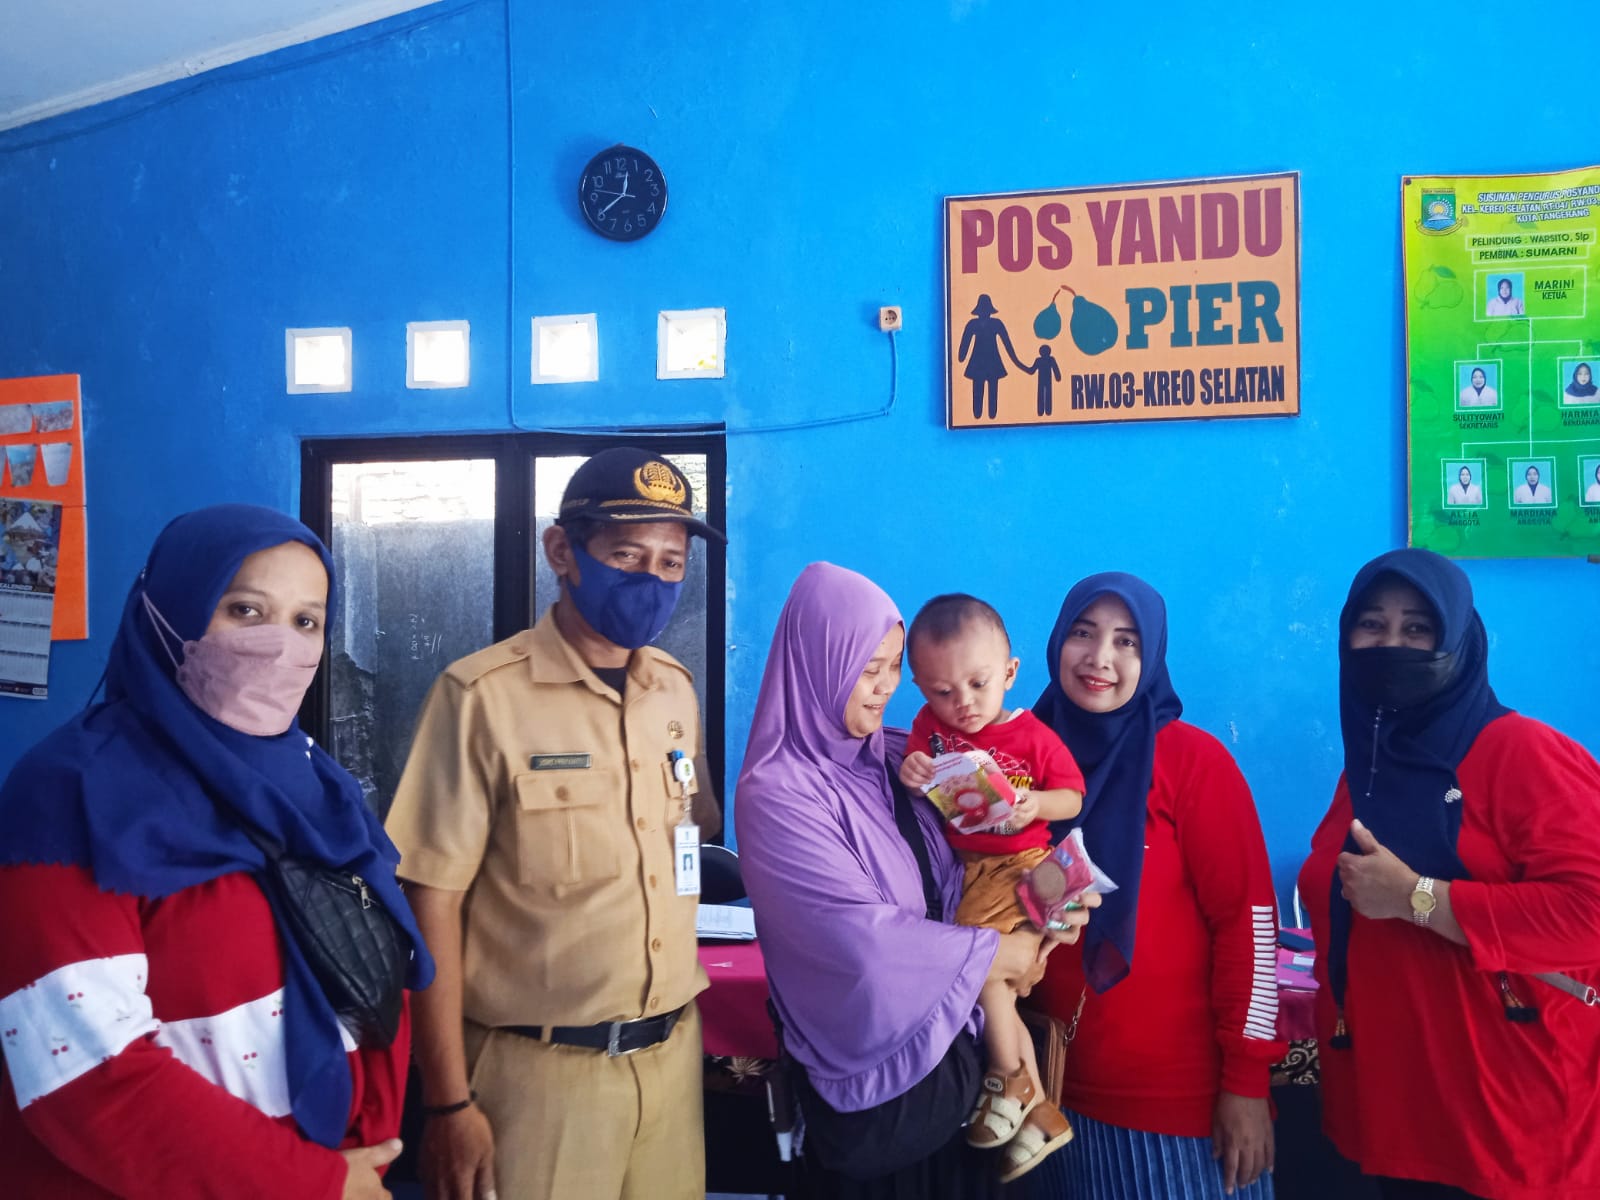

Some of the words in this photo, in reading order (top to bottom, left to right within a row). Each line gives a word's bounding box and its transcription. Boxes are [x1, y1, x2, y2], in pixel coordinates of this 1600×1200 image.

[603, 160, 612, 175] 11
[615, 157, 626, 170] 12
[633, 159, 639, 172] 1
[592, 175, 603, 188] 10
[644, 168, 653, 182] 2
[650, 183, 660, 197] 3
[1478, 192, 1516, 203] SUSUNAN
[1517, 190, 1561, 203] PENGURUS
[590, 192, 599, 206] 9
[647, 202, 656, 215] 4
[1505, 202, 1541, 213] SELATAN
[638, 214, 647, 227] 5
[1515, 212, 1538, 224] KOTA
[1539, 208, 1590, 221] TANGERANG
[609, 218, 617, 231] 7
[624, 219, 633, 232] 6
[961, 202, 1073, 274] POS
[1086, 187, 1283, 267] YANDU
[1472, 236, 1522, 246] PELINDUNG
[1479, 250, 1518, 260] PEMBINA
[1526, 247, 1577, 257] SUMARNI
[1534, 279, 1574, 290] MARINI
[1542, 292, 1567, 300] KETUA
[1125, 280, 1284, 350] PIER
[1199, 365, 1286, 405] SELATAN
